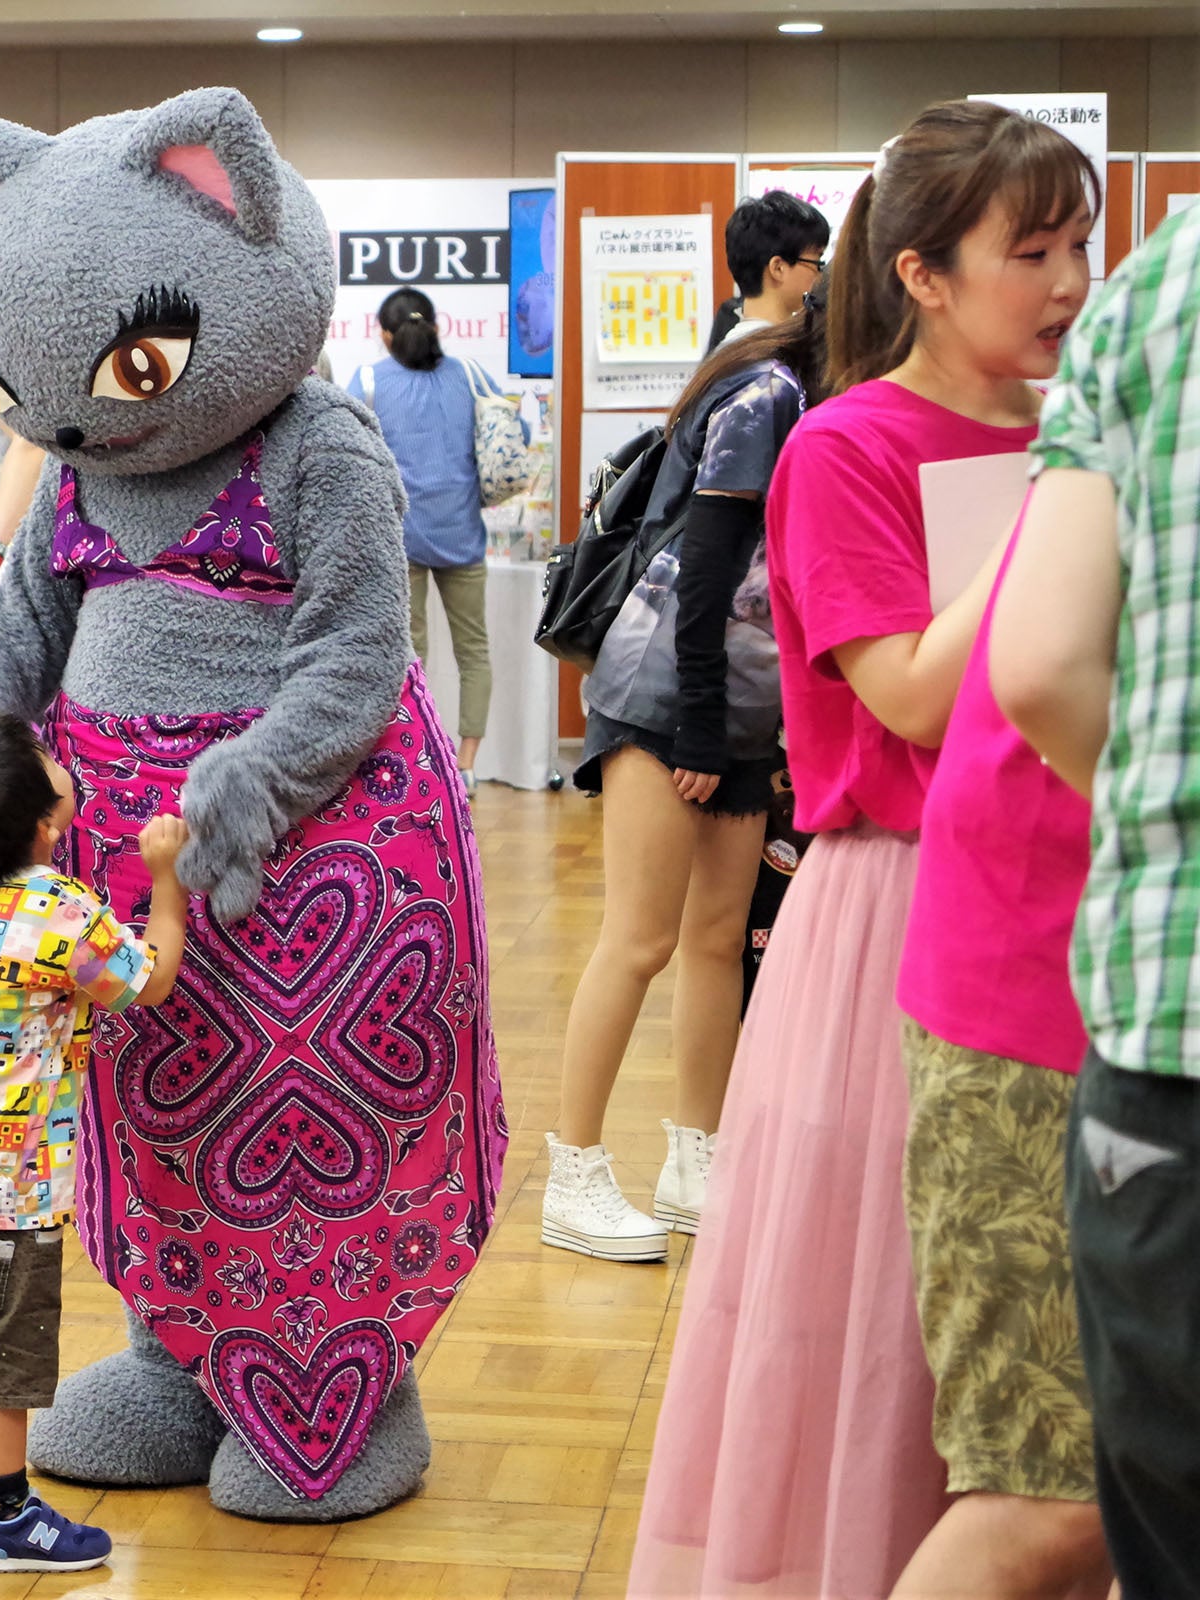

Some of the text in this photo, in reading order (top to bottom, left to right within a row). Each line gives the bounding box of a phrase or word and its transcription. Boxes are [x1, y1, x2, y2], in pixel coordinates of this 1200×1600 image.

[1014, 108, 1102, 124] Aの活動を
[27, 1521, 60, 1551] N
